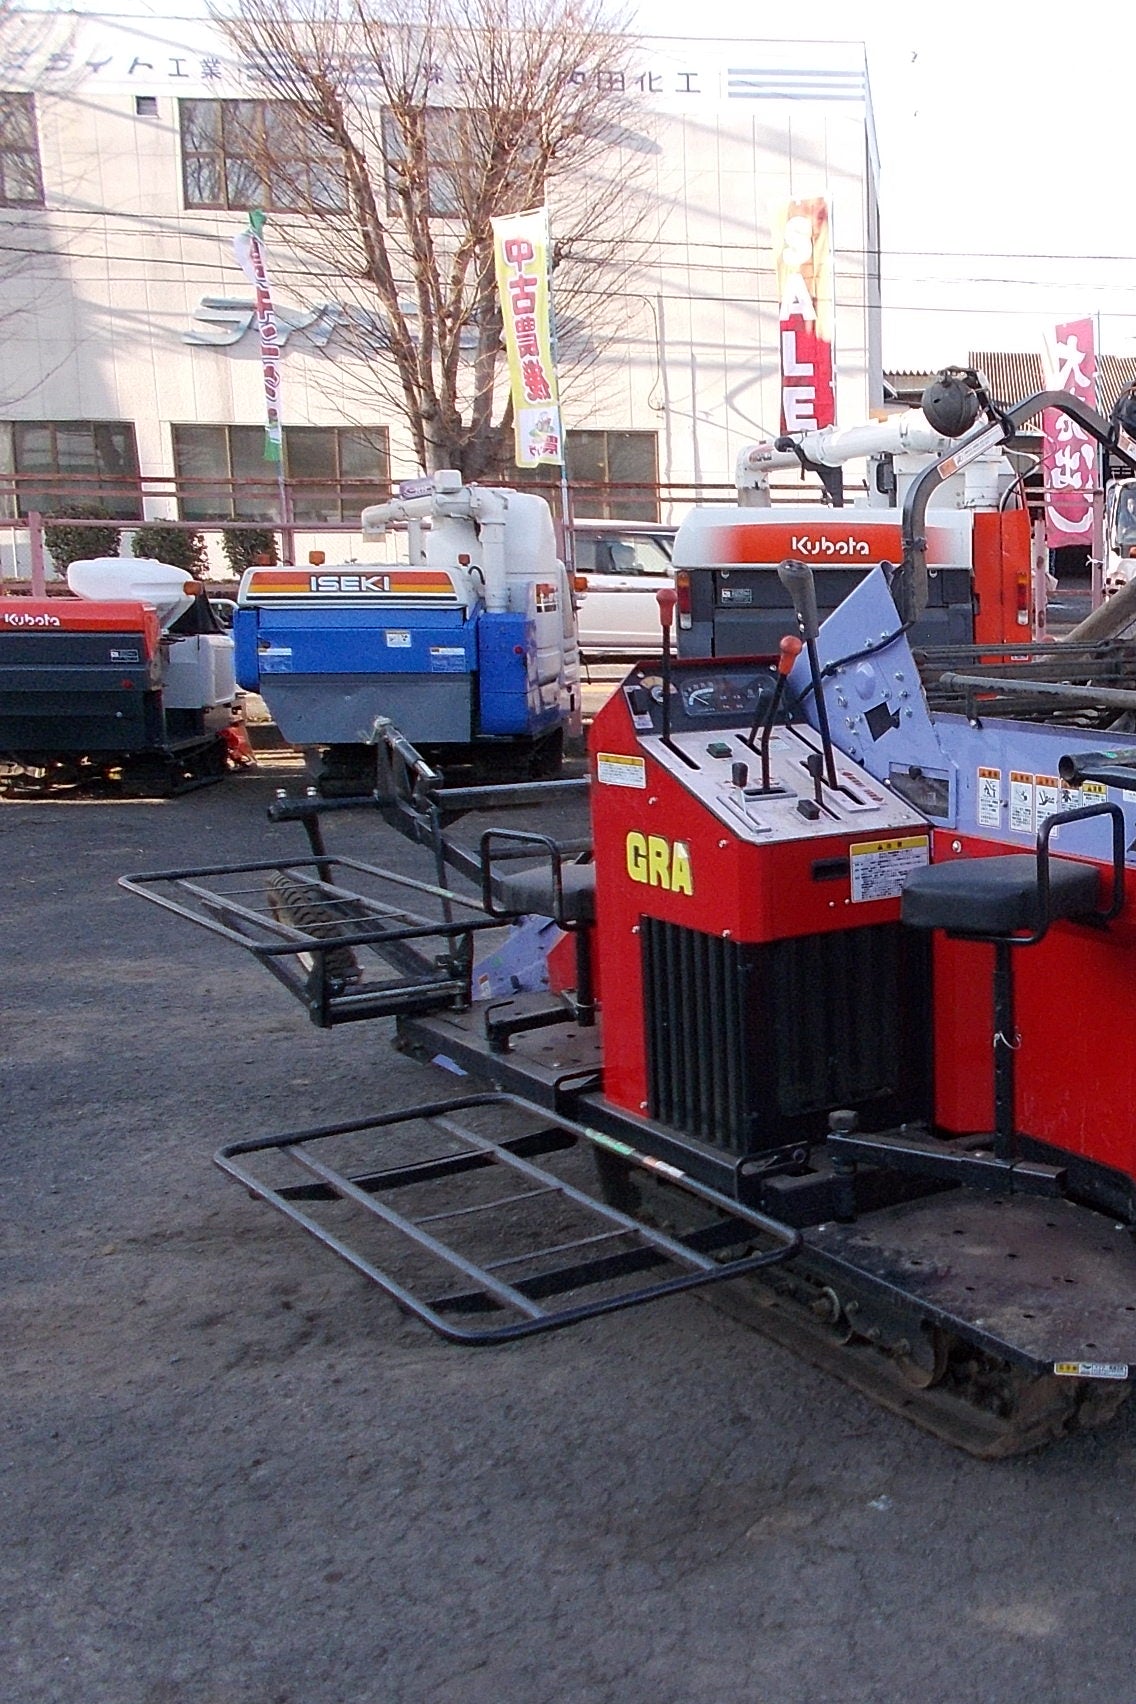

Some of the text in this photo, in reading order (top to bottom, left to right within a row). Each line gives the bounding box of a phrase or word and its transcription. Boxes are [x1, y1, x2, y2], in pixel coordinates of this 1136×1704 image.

[779, 215, 819, 432] SALE
[790, 536, 870, 555] Kubota
[309, 575, 391, 592] ISEKI
[4, 613, 61, 626] Kubota
[625, 830, 695, 897] GRA
